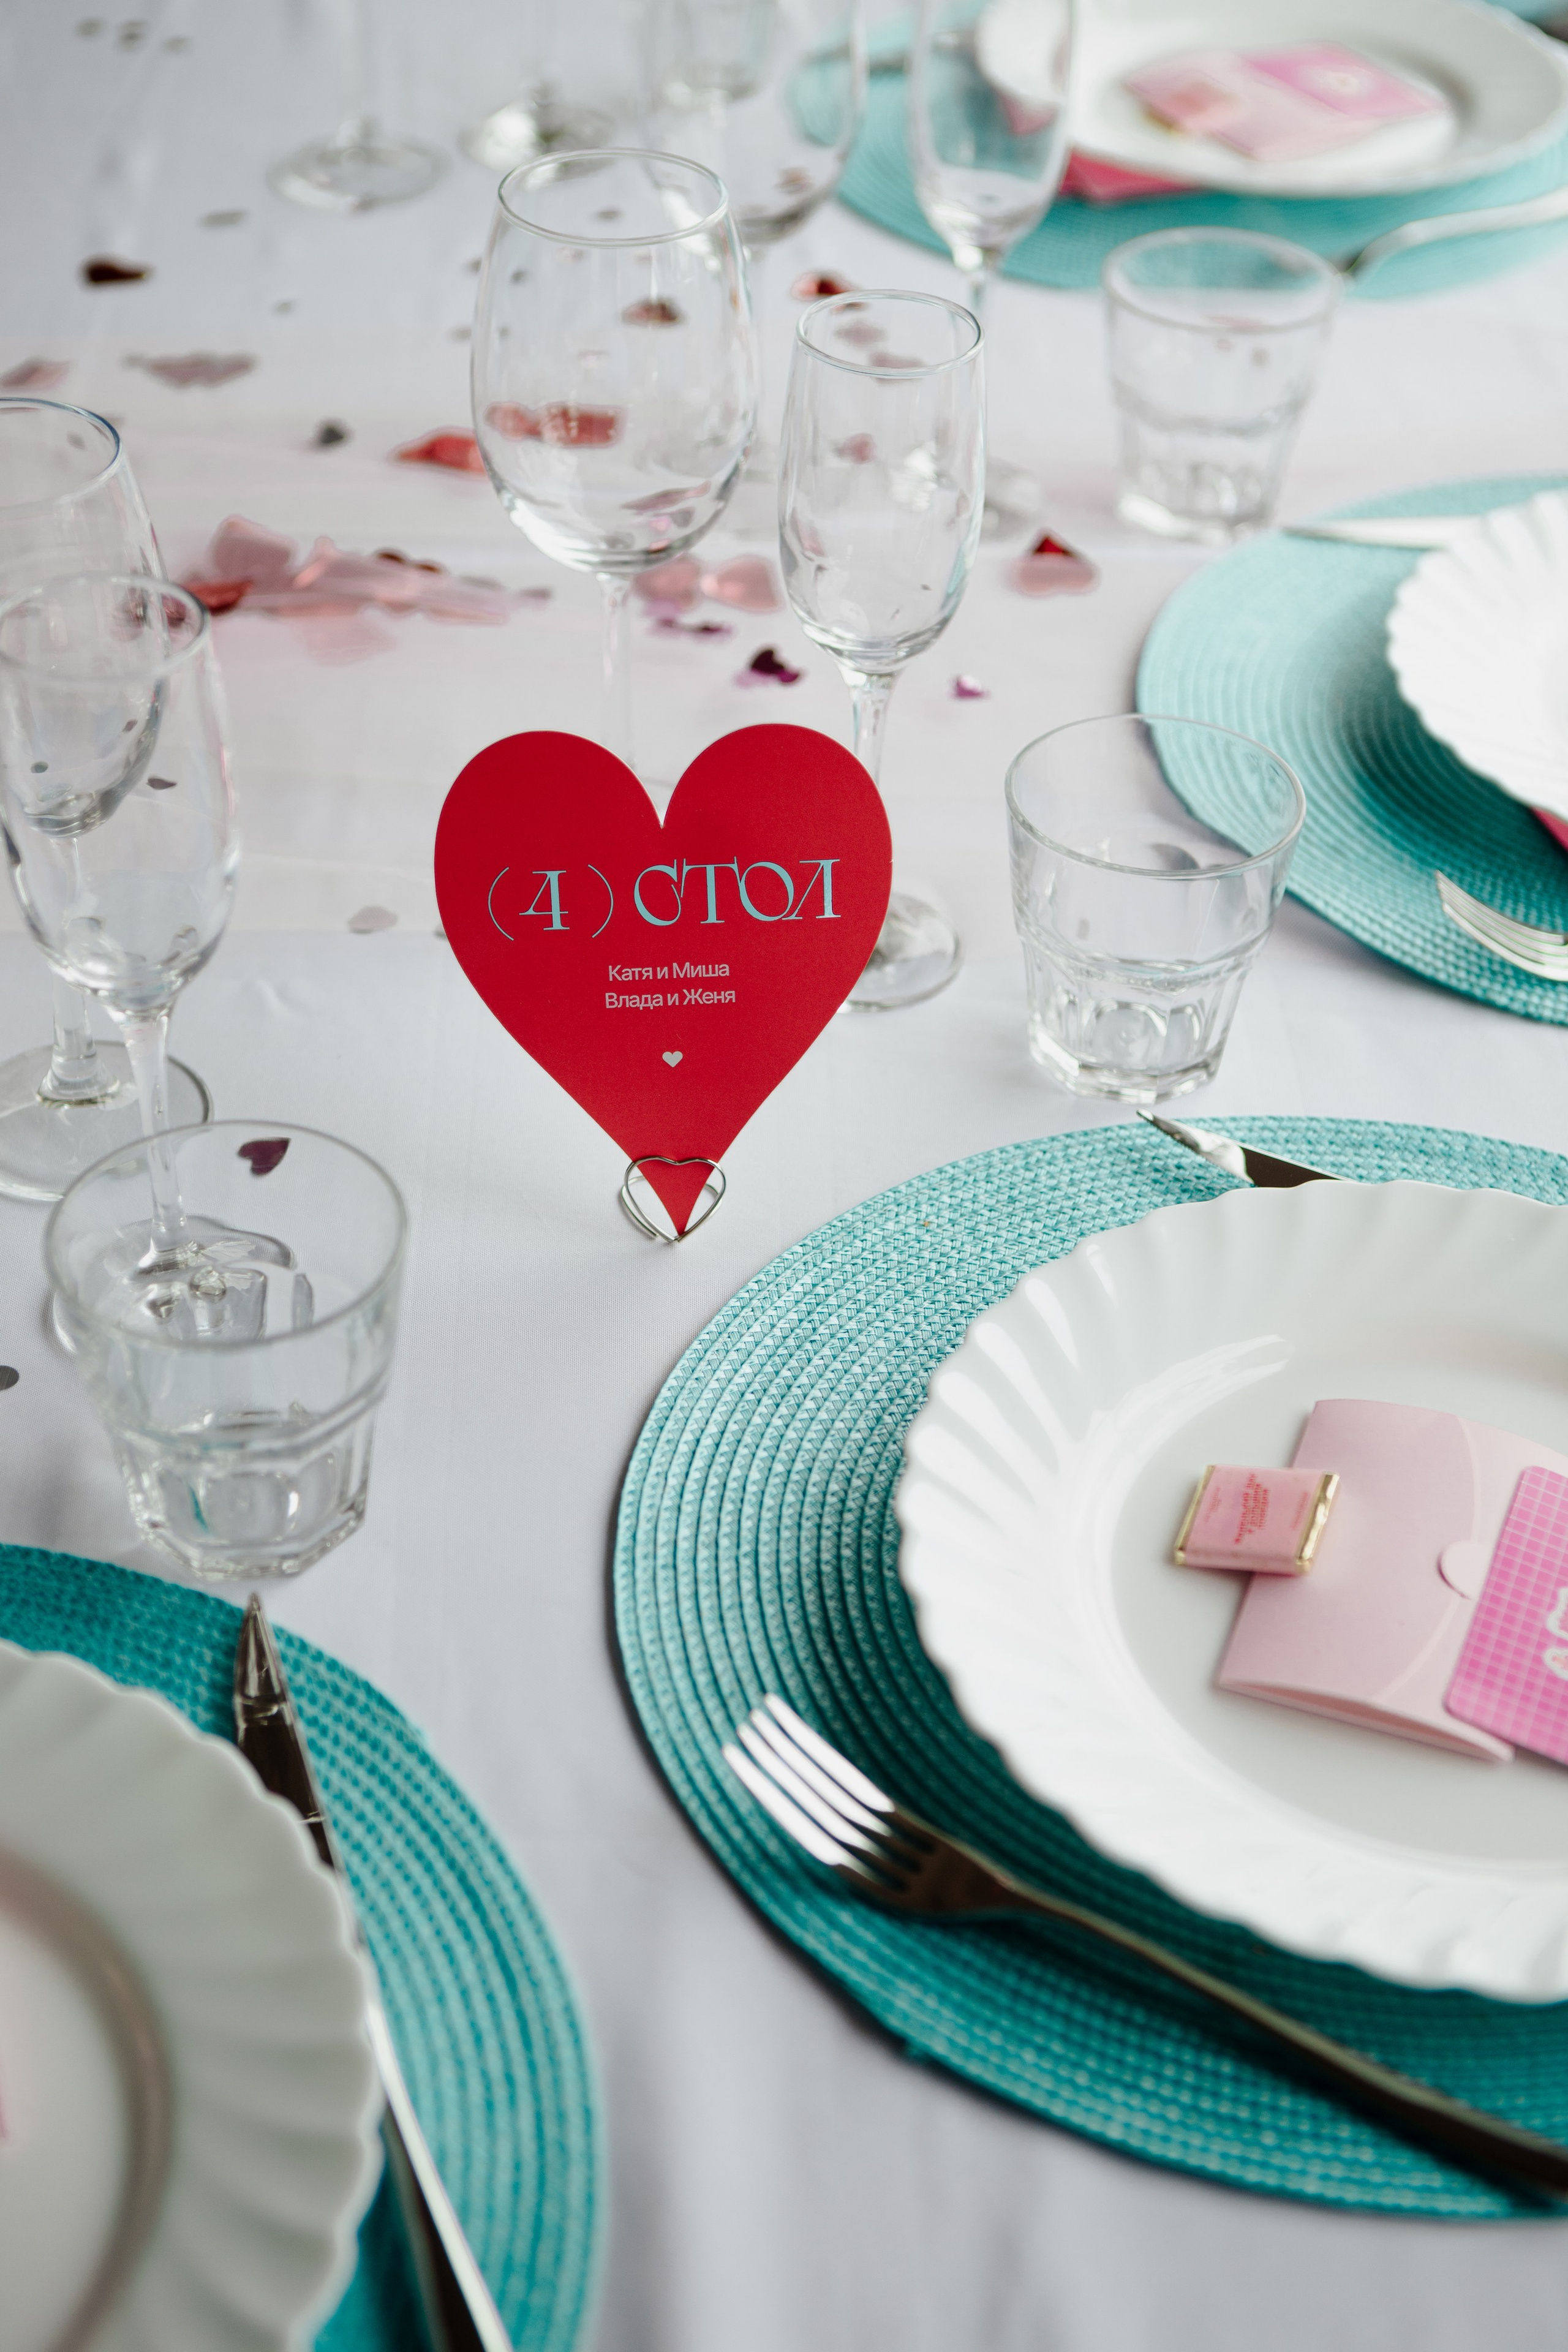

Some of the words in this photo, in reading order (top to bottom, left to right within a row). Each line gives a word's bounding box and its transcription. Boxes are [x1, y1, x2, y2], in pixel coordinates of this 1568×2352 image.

[634, 856, 842, 926] СТОЛ
[608, 965, 653, 982] Катя
[657, 967, 669, 979] и
[673, 962, 730, 978] Миша
[605, 993, 663, 1011] Влада
[667, 993, 679, 1006] и
[682, 988, 736, 1005] Женя
